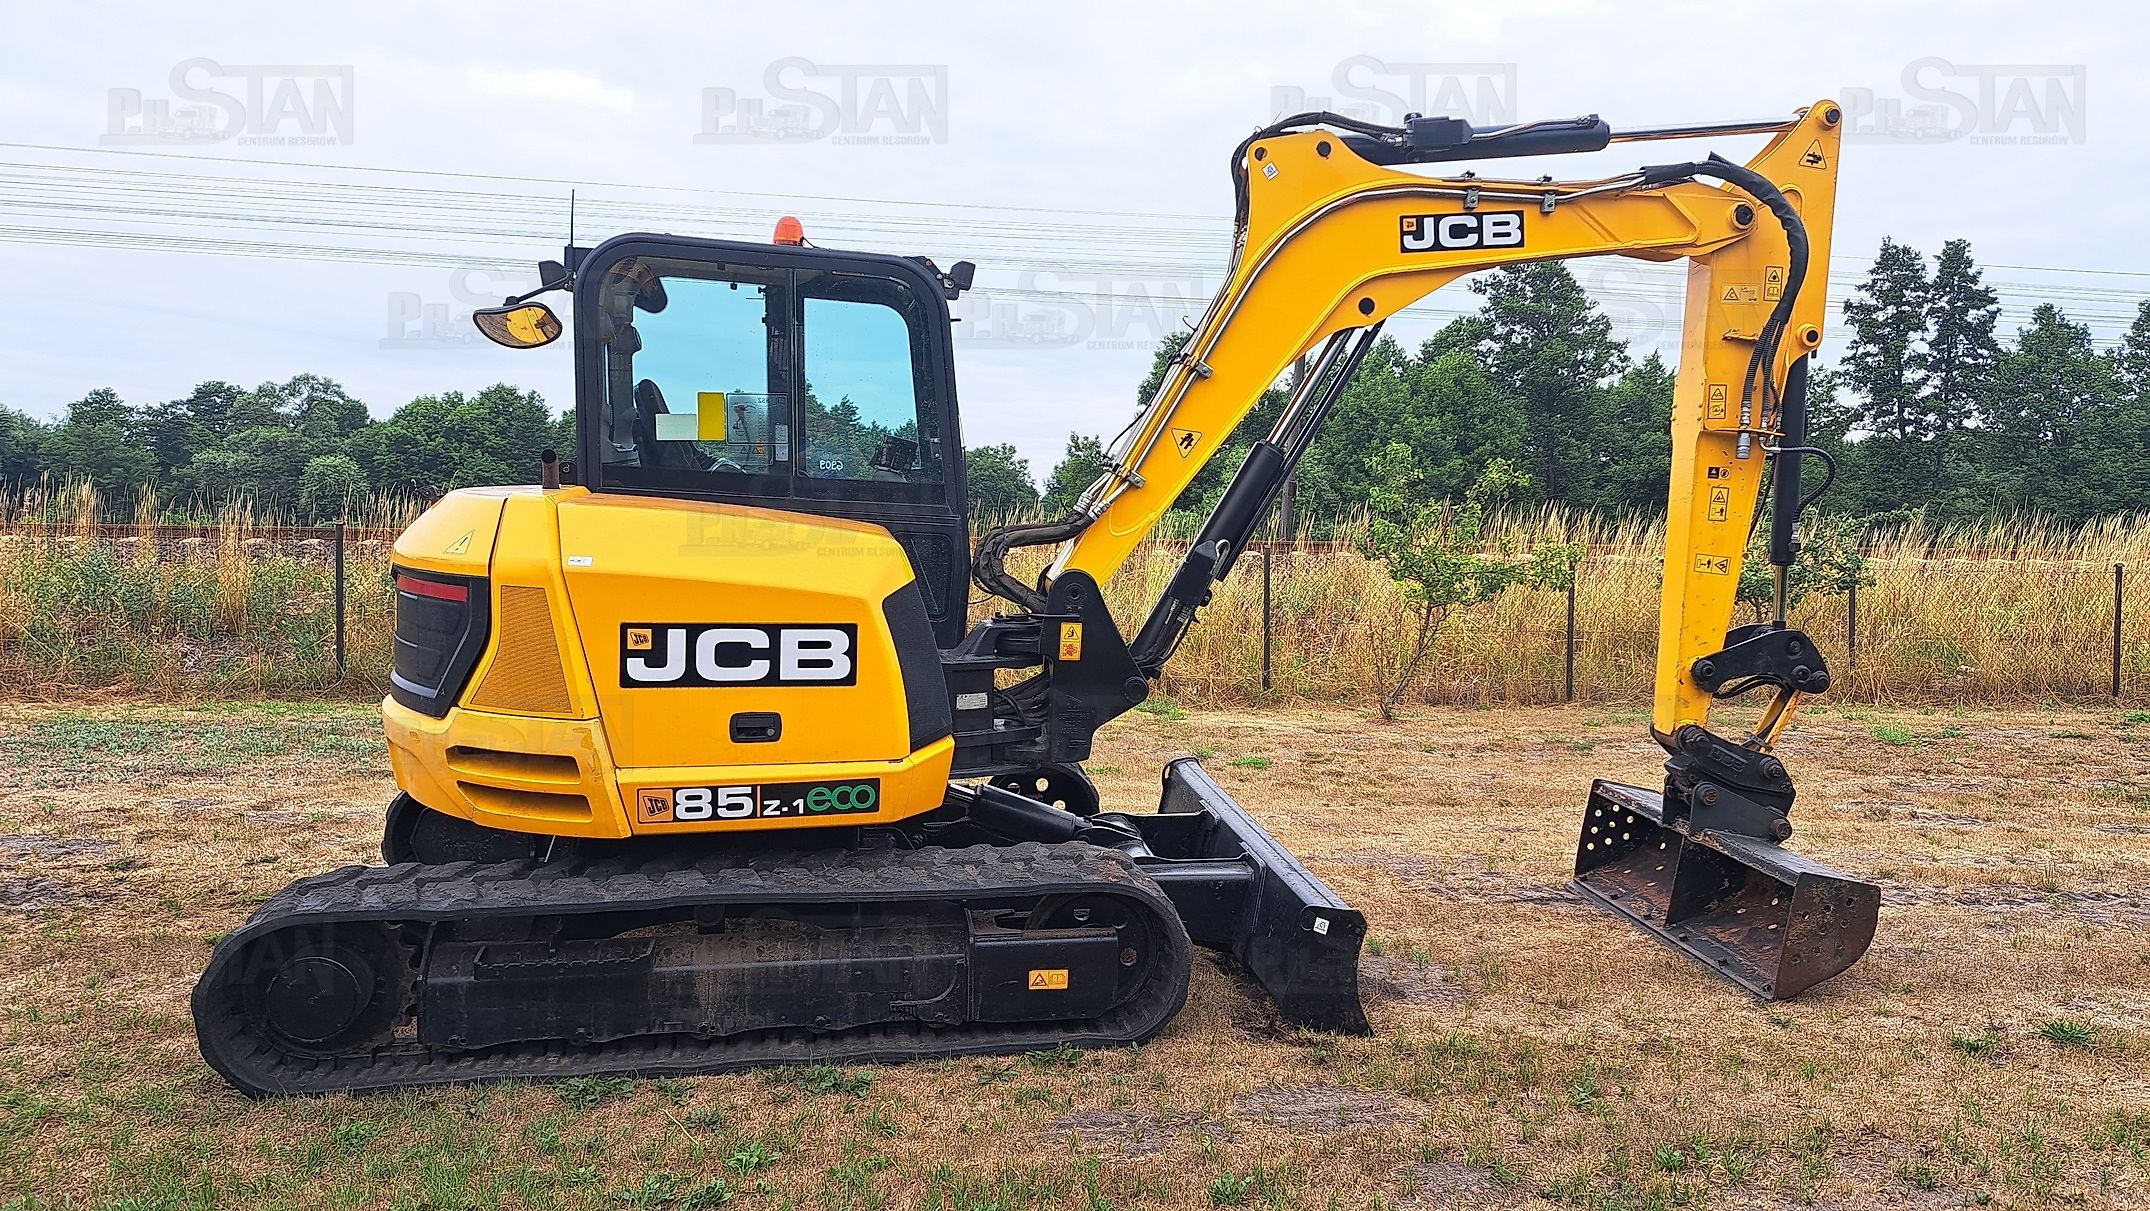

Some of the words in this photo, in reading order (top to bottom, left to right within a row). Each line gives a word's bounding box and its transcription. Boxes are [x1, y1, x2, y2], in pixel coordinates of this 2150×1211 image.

[1403, 214, 1521, 249] JCB
[627, 628, 851, 682] JCB
[647, 797, 669, 815] JCB
[675, 786, 753, 820] 85
[807, 784, 876, 812] eco
